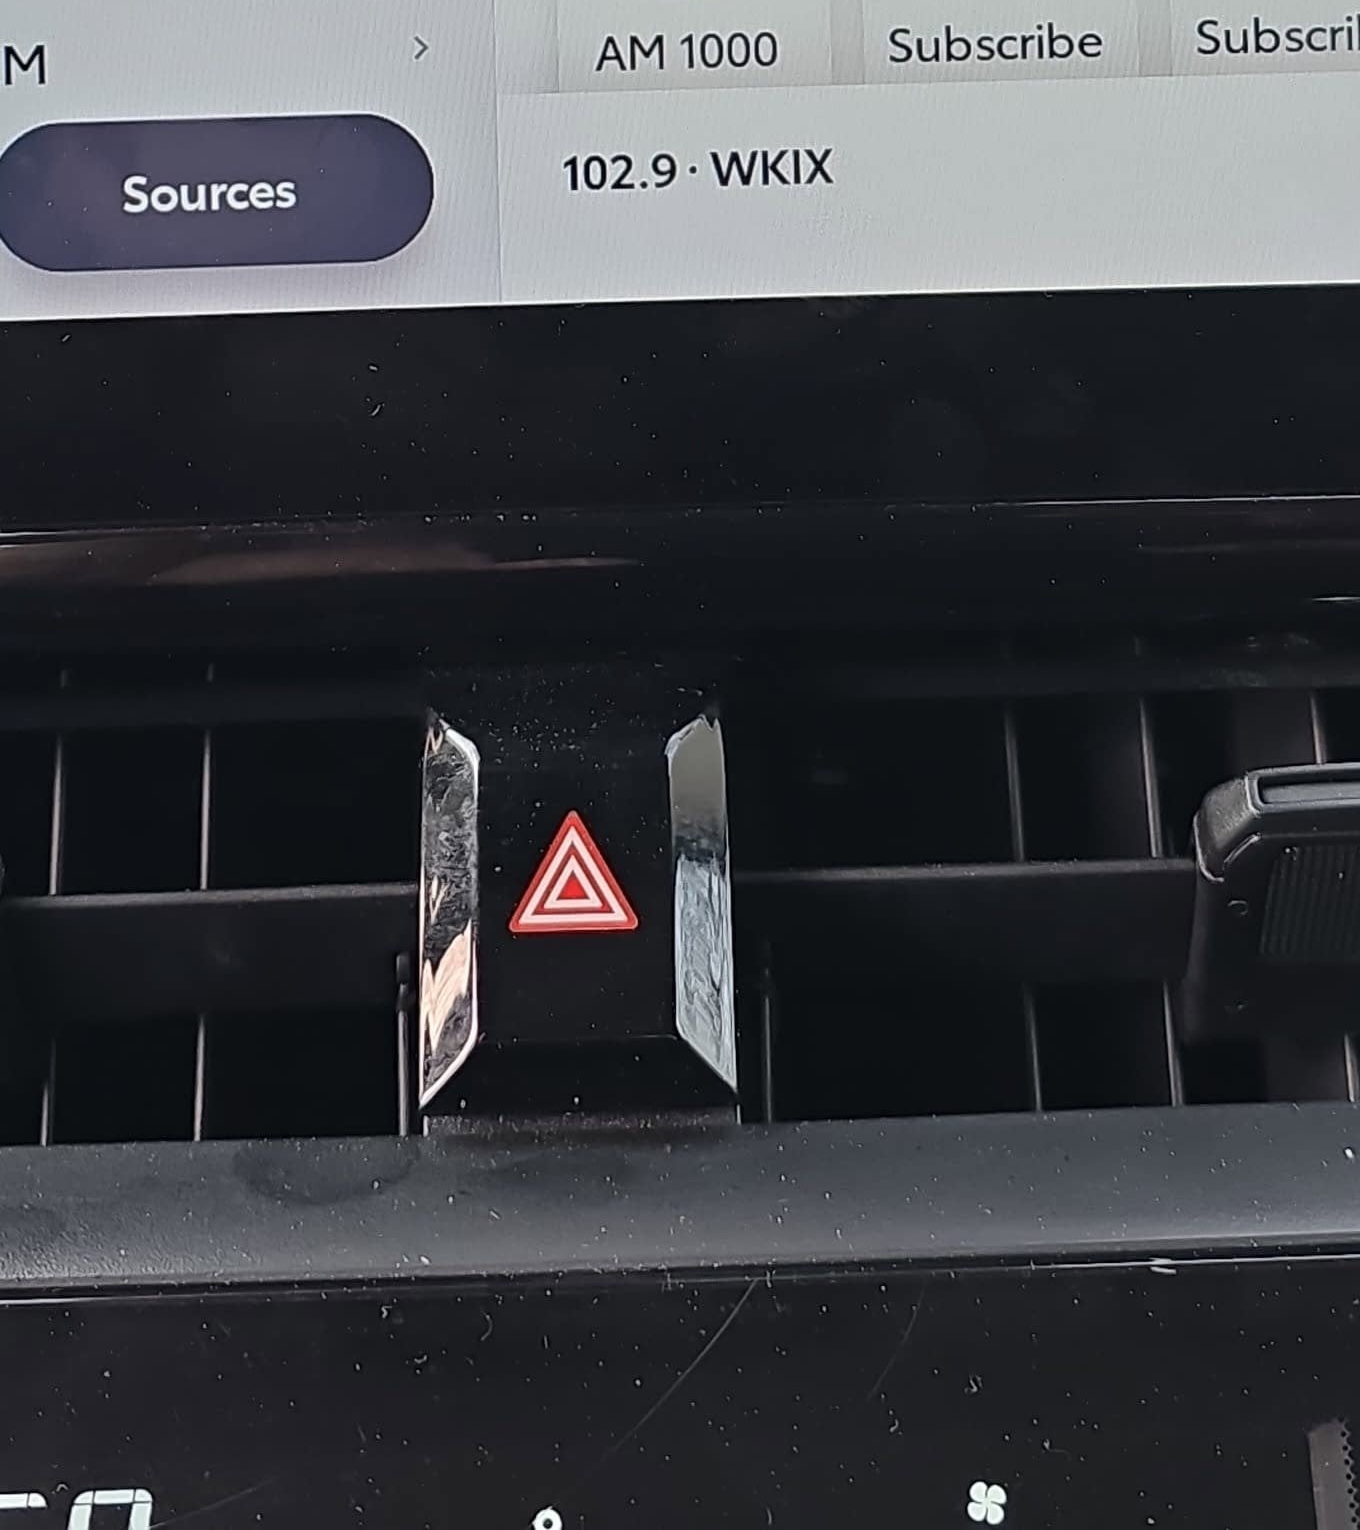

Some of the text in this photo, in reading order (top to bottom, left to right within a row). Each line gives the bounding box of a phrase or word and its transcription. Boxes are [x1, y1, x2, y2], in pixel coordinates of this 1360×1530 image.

[594, 30, 779, 73] AM 1000
[888, 20, 1104, 64] Subscribe
[562, 152, 678, 192] 102.9
[708, 147, 835, 188] WKIX
[122, 174, 298, 214] Sources
